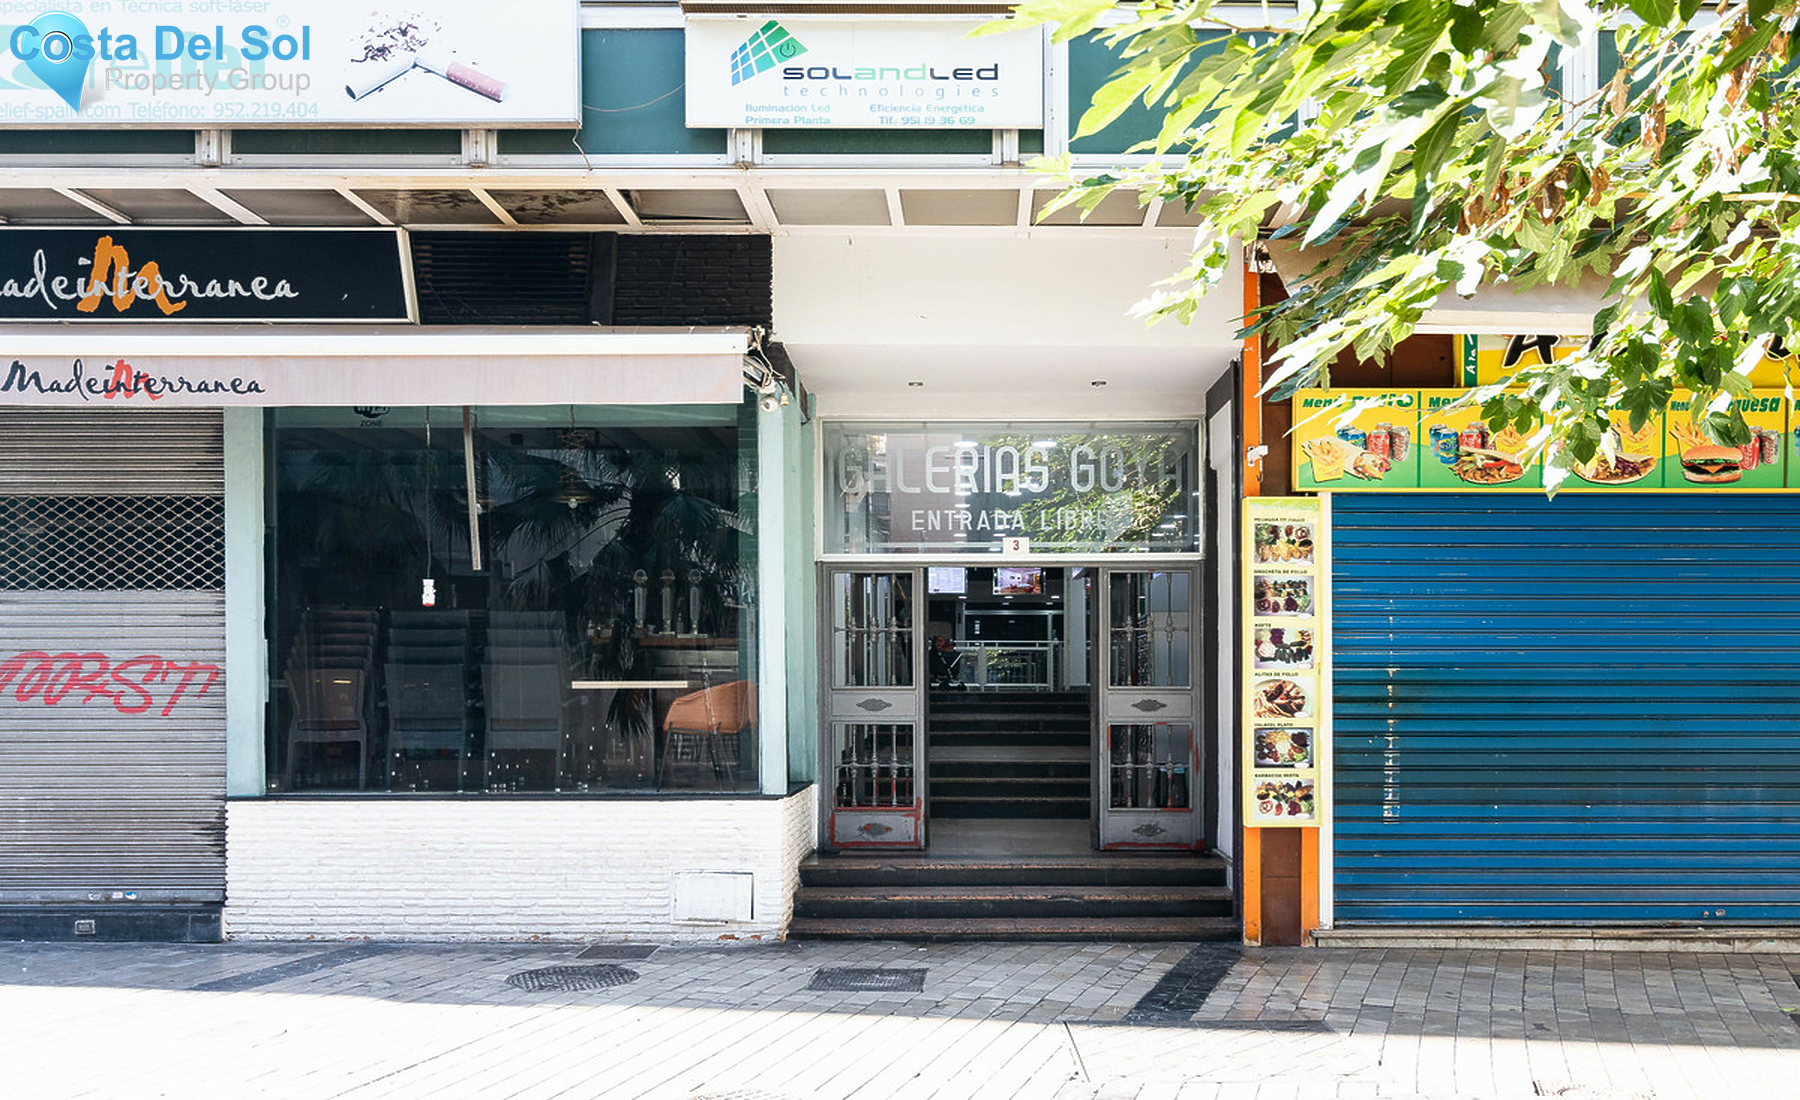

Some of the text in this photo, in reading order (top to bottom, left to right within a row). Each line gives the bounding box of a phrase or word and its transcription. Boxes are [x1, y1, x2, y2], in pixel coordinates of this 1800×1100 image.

[0, 0, 82, 16] pecialista
[90, 2, 111, 12] en
[784, 84, 998, 100] technologies
[128, 102, 204, 118] Teléfono:
[214, 102, 319, 118] 952.219.404
[811, 103, 830, 112] Led
[869, 103, 921, 113] Eficiencia
[745, 115, 831, 125] Primera Planta
[901, 116, 920, 125] 951
[940, 116, 955, 125] 36
[959, 116, 976, 125] 69
[0, 249, 299, 310] adeinterranea
[838, 445, 1049, 494] GALERIAS
[912, 510, 1025, 531] ENTRADA
[1012, 539, 1020, 551] 3
